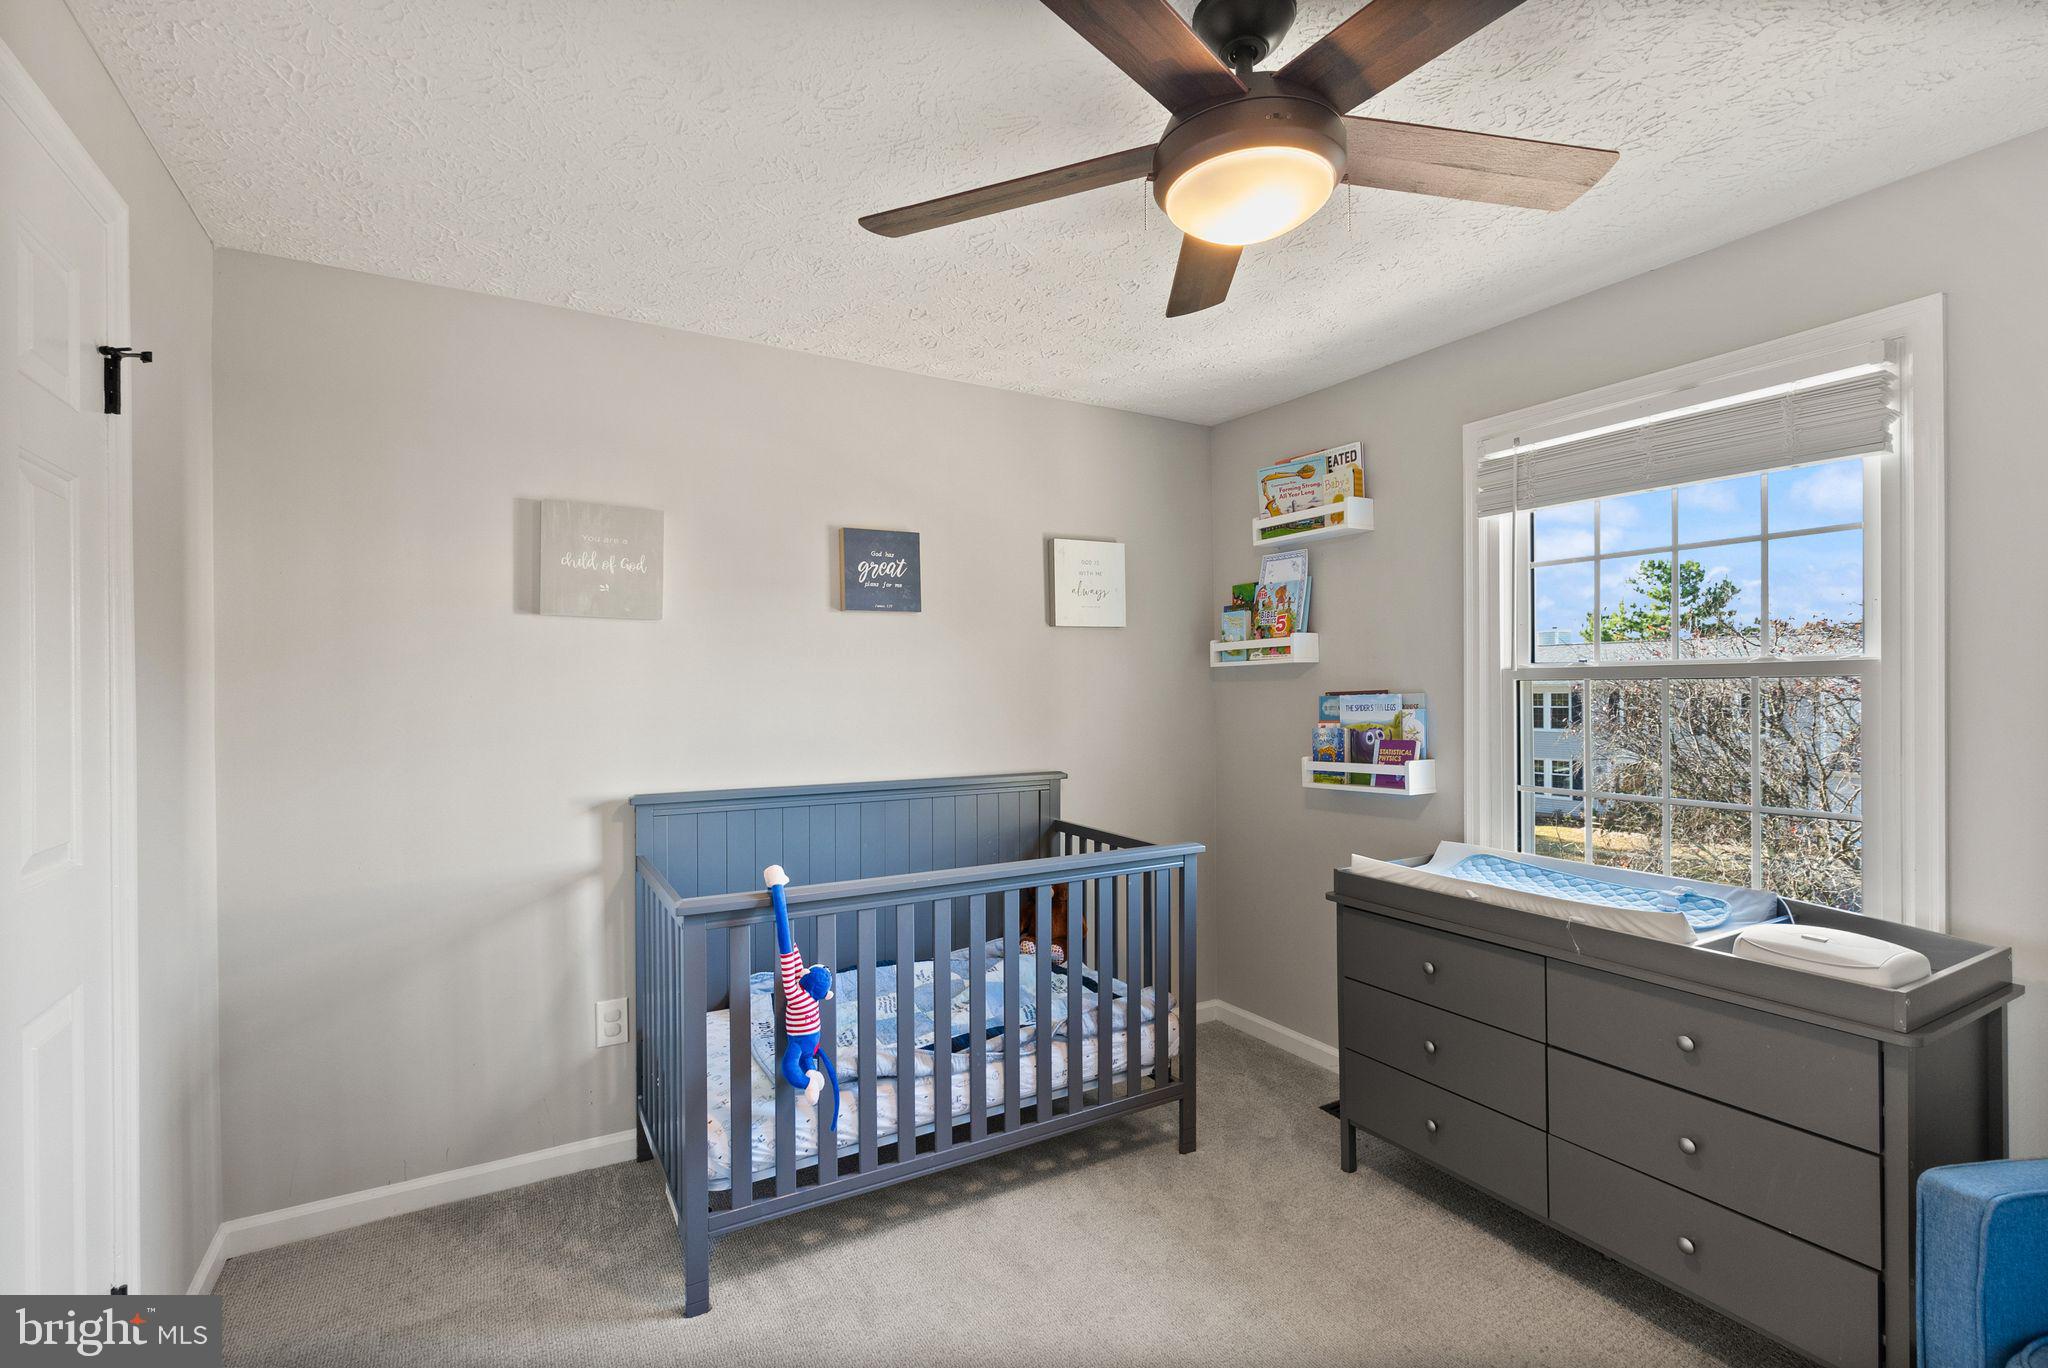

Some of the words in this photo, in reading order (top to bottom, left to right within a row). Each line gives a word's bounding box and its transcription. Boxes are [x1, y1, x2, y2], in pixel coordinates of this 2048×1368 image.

[561, 550, 598, 571] child
[602, 555, 616, 574] of
[620, 554, 647, 574] God
[858, 558, 908, 583] great
[1071, 580, 1110, 601] always
[1261, 610, 1277, 619] BIBLE
[1275, 613, 1287, 633] 5
[1385, 703, 1396, 711] LEGS
[1379, 748, 1412, 756] STATISTICAL
